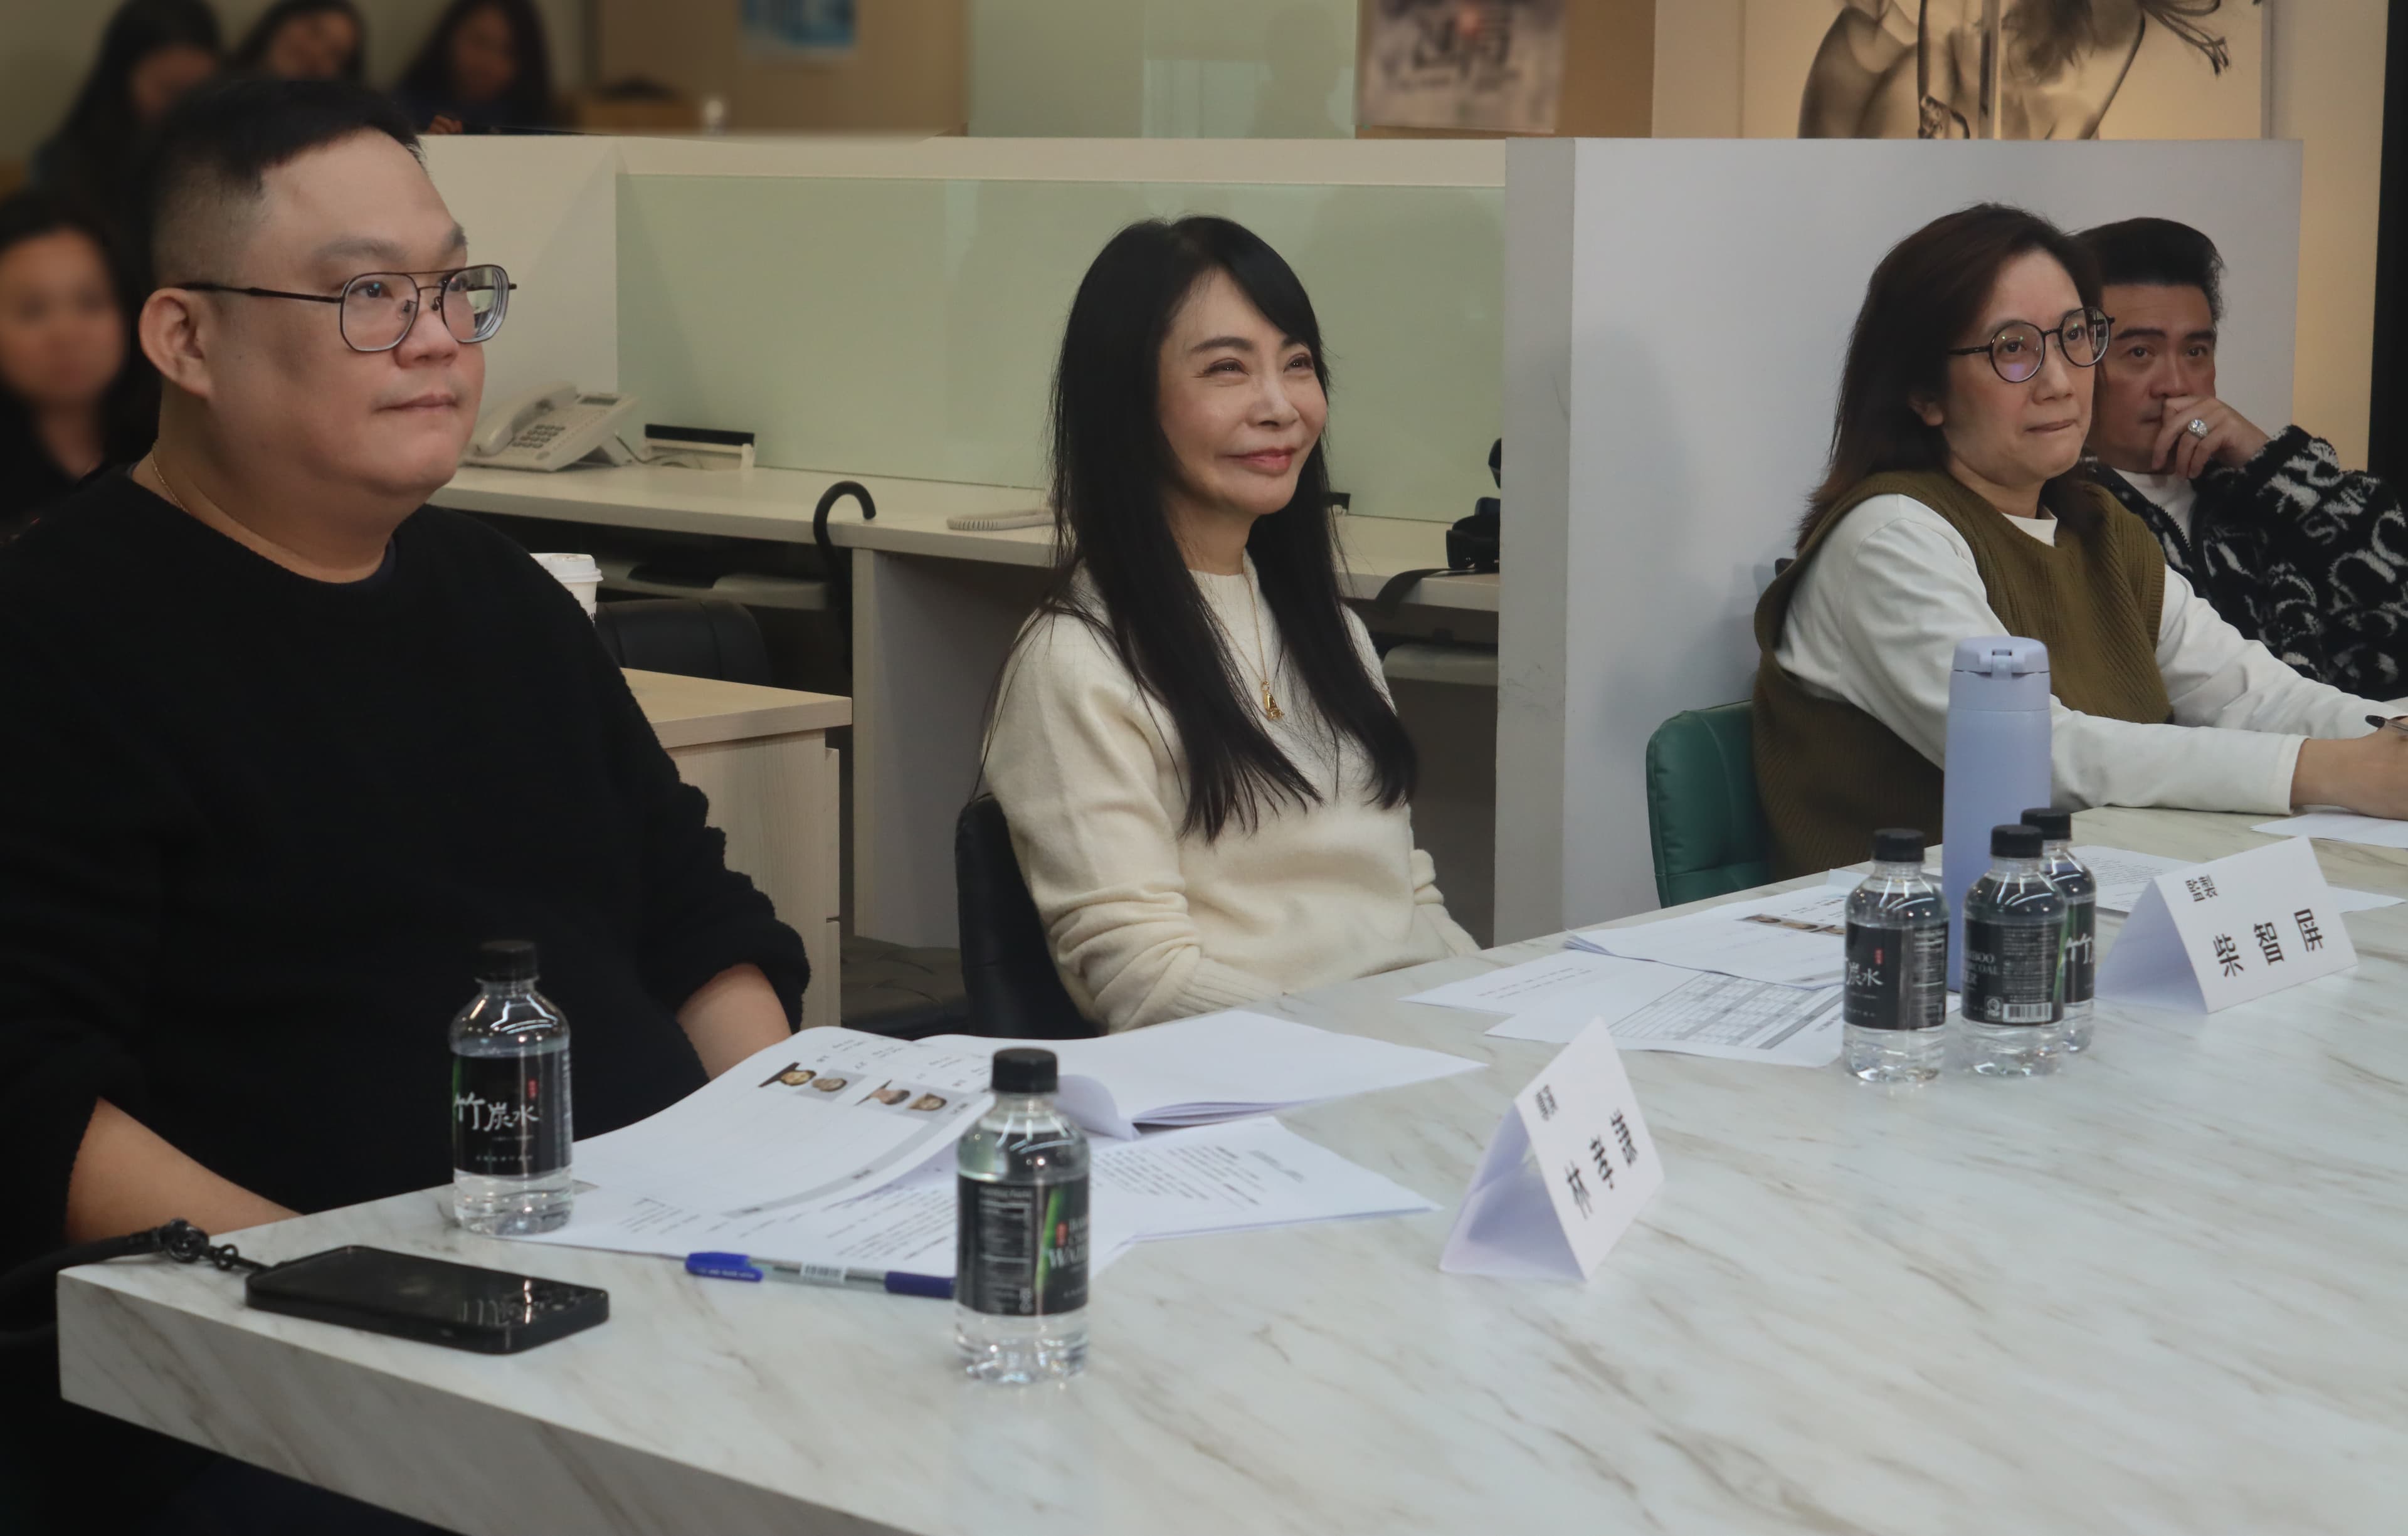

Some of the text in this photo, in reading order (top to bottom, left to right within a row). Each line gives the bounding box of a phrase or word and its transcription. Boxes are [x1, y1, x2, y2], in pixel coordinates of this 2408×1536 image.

[2185, 875, 2218, 902] 監製
[2213, 908, 2323, 977] 柴智屏
[1846, 960, 1884, 986] 炭水
[455, 1091, 539, 1132] 竹炭水
[1565, 1108, 1638, 1219] 林孝謙
